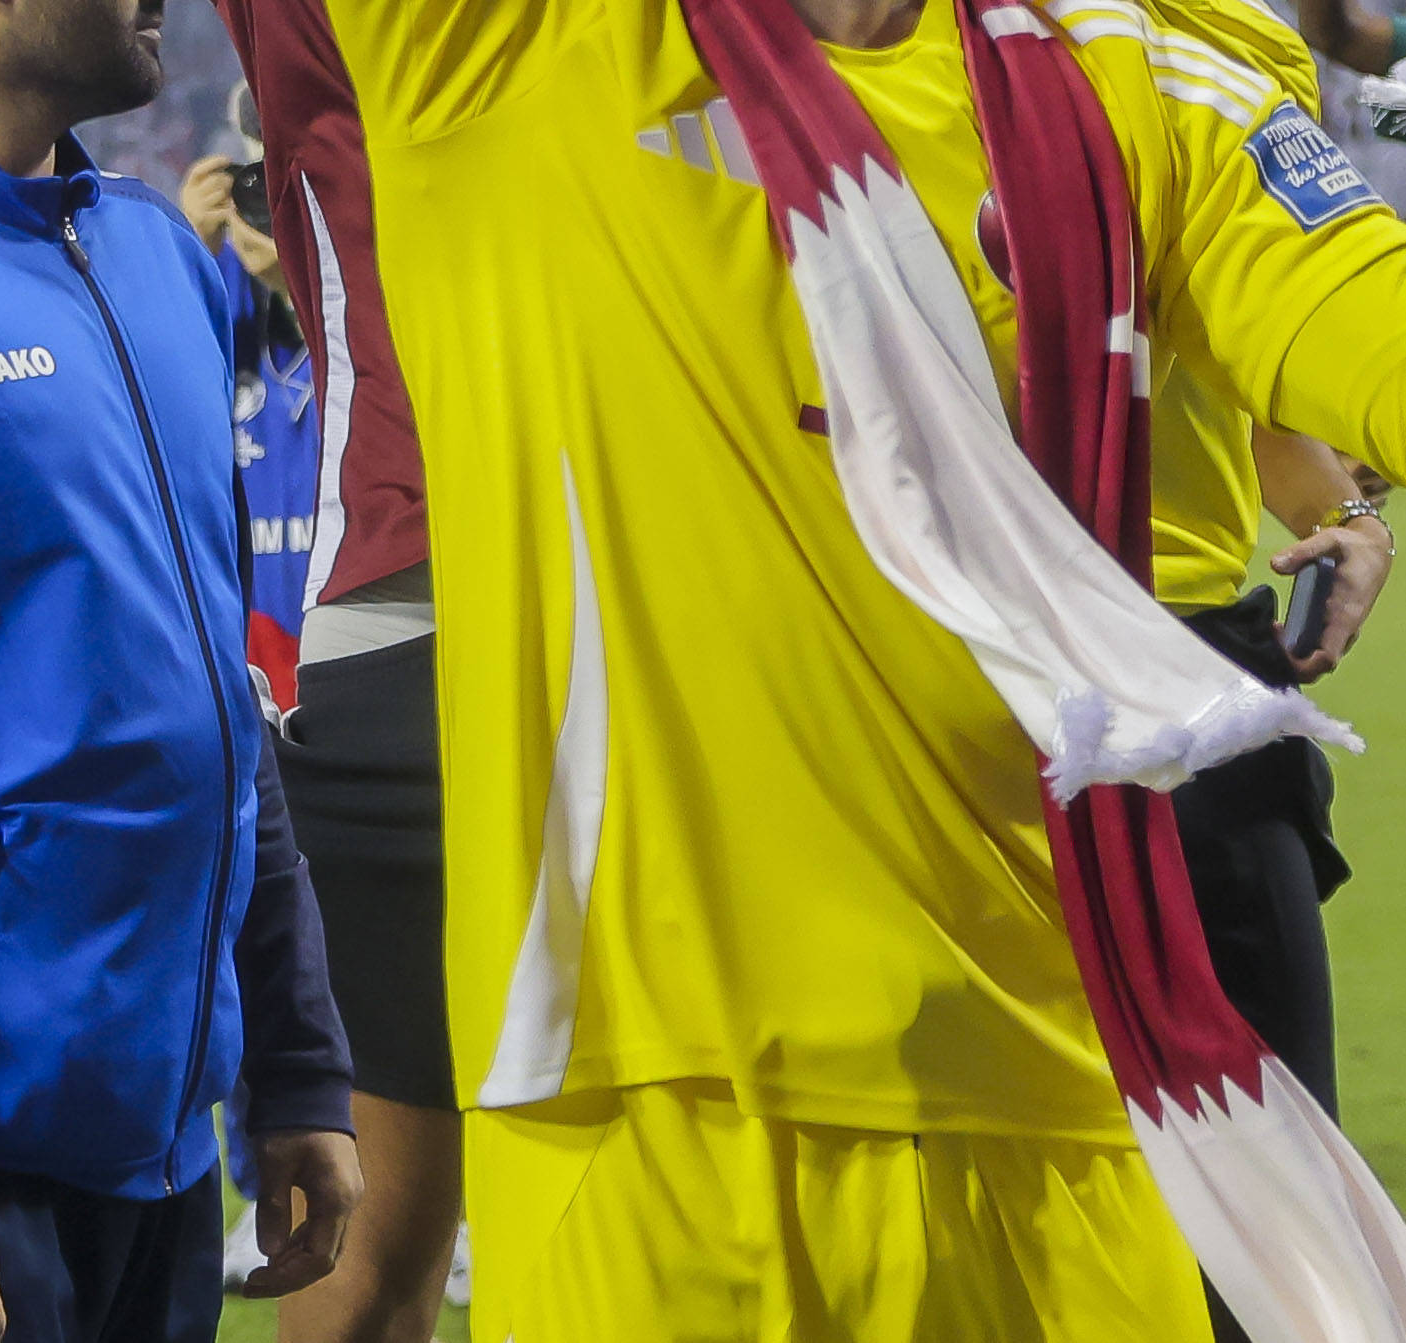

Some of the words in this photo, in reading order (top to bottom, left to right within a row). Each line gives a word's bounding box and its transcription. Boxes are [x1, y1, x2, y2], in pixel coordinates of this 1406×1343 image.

[1272, 127, 1334, 170] UNITE
[1285, 166, 1317, 188] the
[1326, 173, 1355, 190] FIFA
